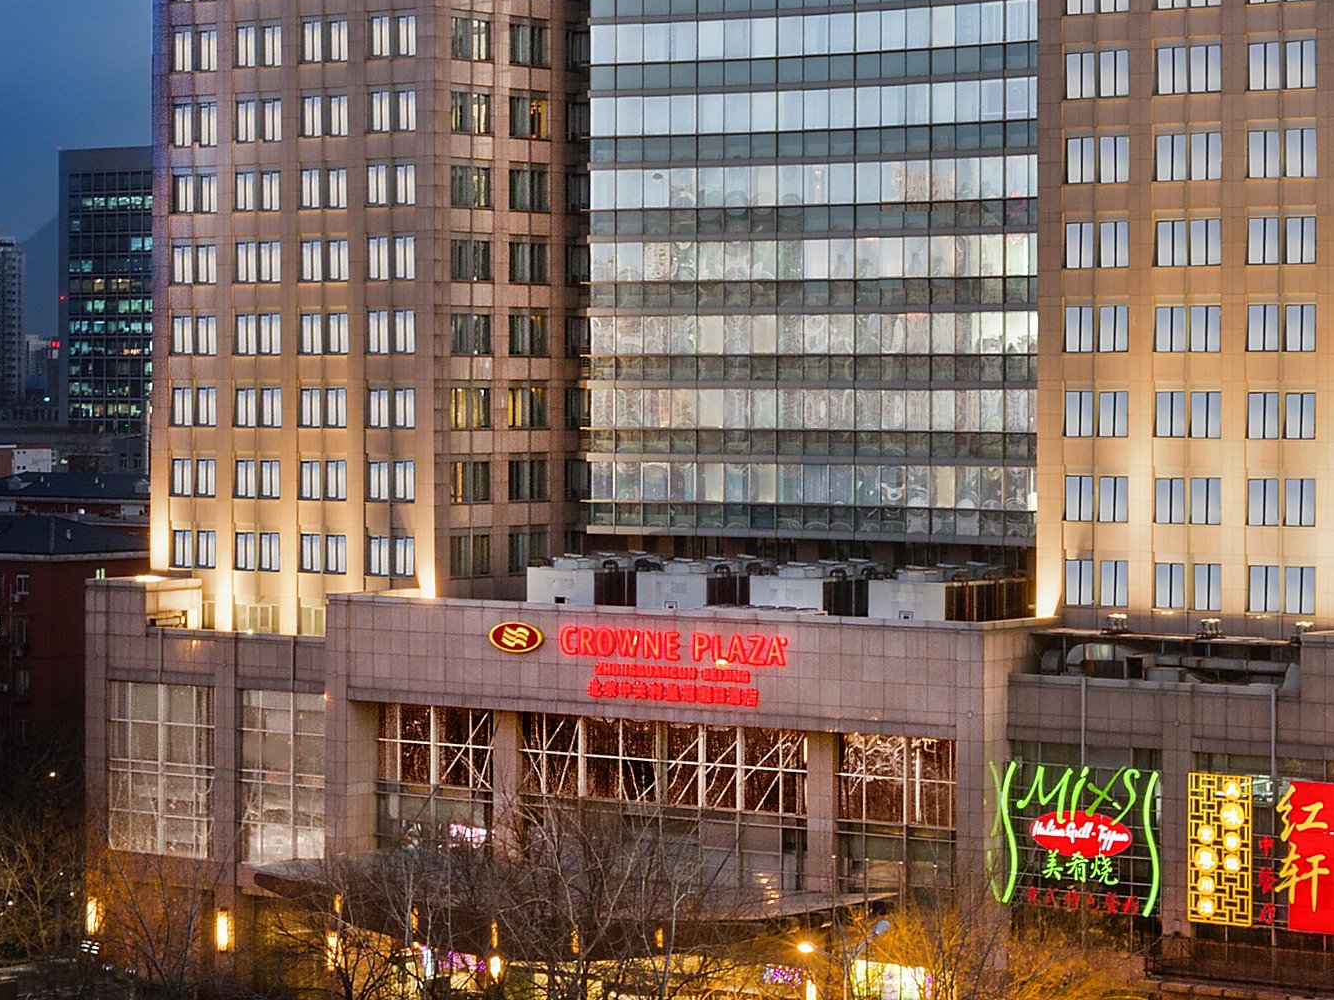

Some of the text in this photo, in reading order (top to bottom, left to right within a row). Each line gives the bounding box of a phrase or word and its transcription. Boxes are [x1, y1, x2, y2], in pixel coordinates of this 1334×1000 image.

[558, 625, 681, 661] CROWNE
[701, 667, 751, 684] BEIJING
[1275, 784, 1330, 912] 红轩
[1042, 848, 1119, 886] 美肴烧
